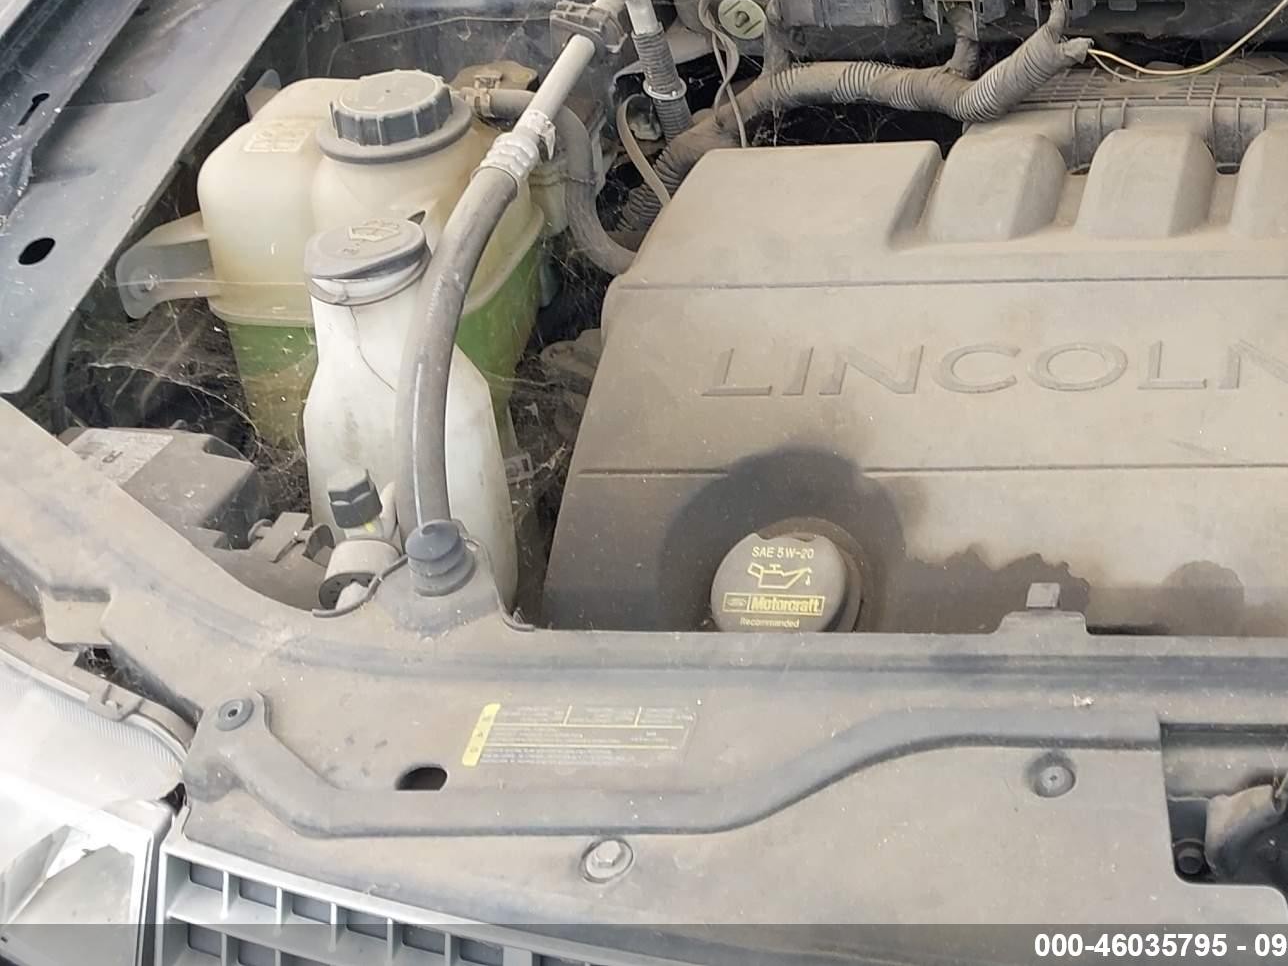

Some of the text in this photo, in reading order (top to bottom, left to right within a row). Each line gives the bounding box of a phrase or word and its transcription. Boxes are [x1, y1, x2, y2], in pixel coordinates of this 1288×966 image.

[751, 546, 815, 559] SAE 5W-20
[751, 596, 819, 612] Motorcraft
[740, 617, 800, 628] Recommended
